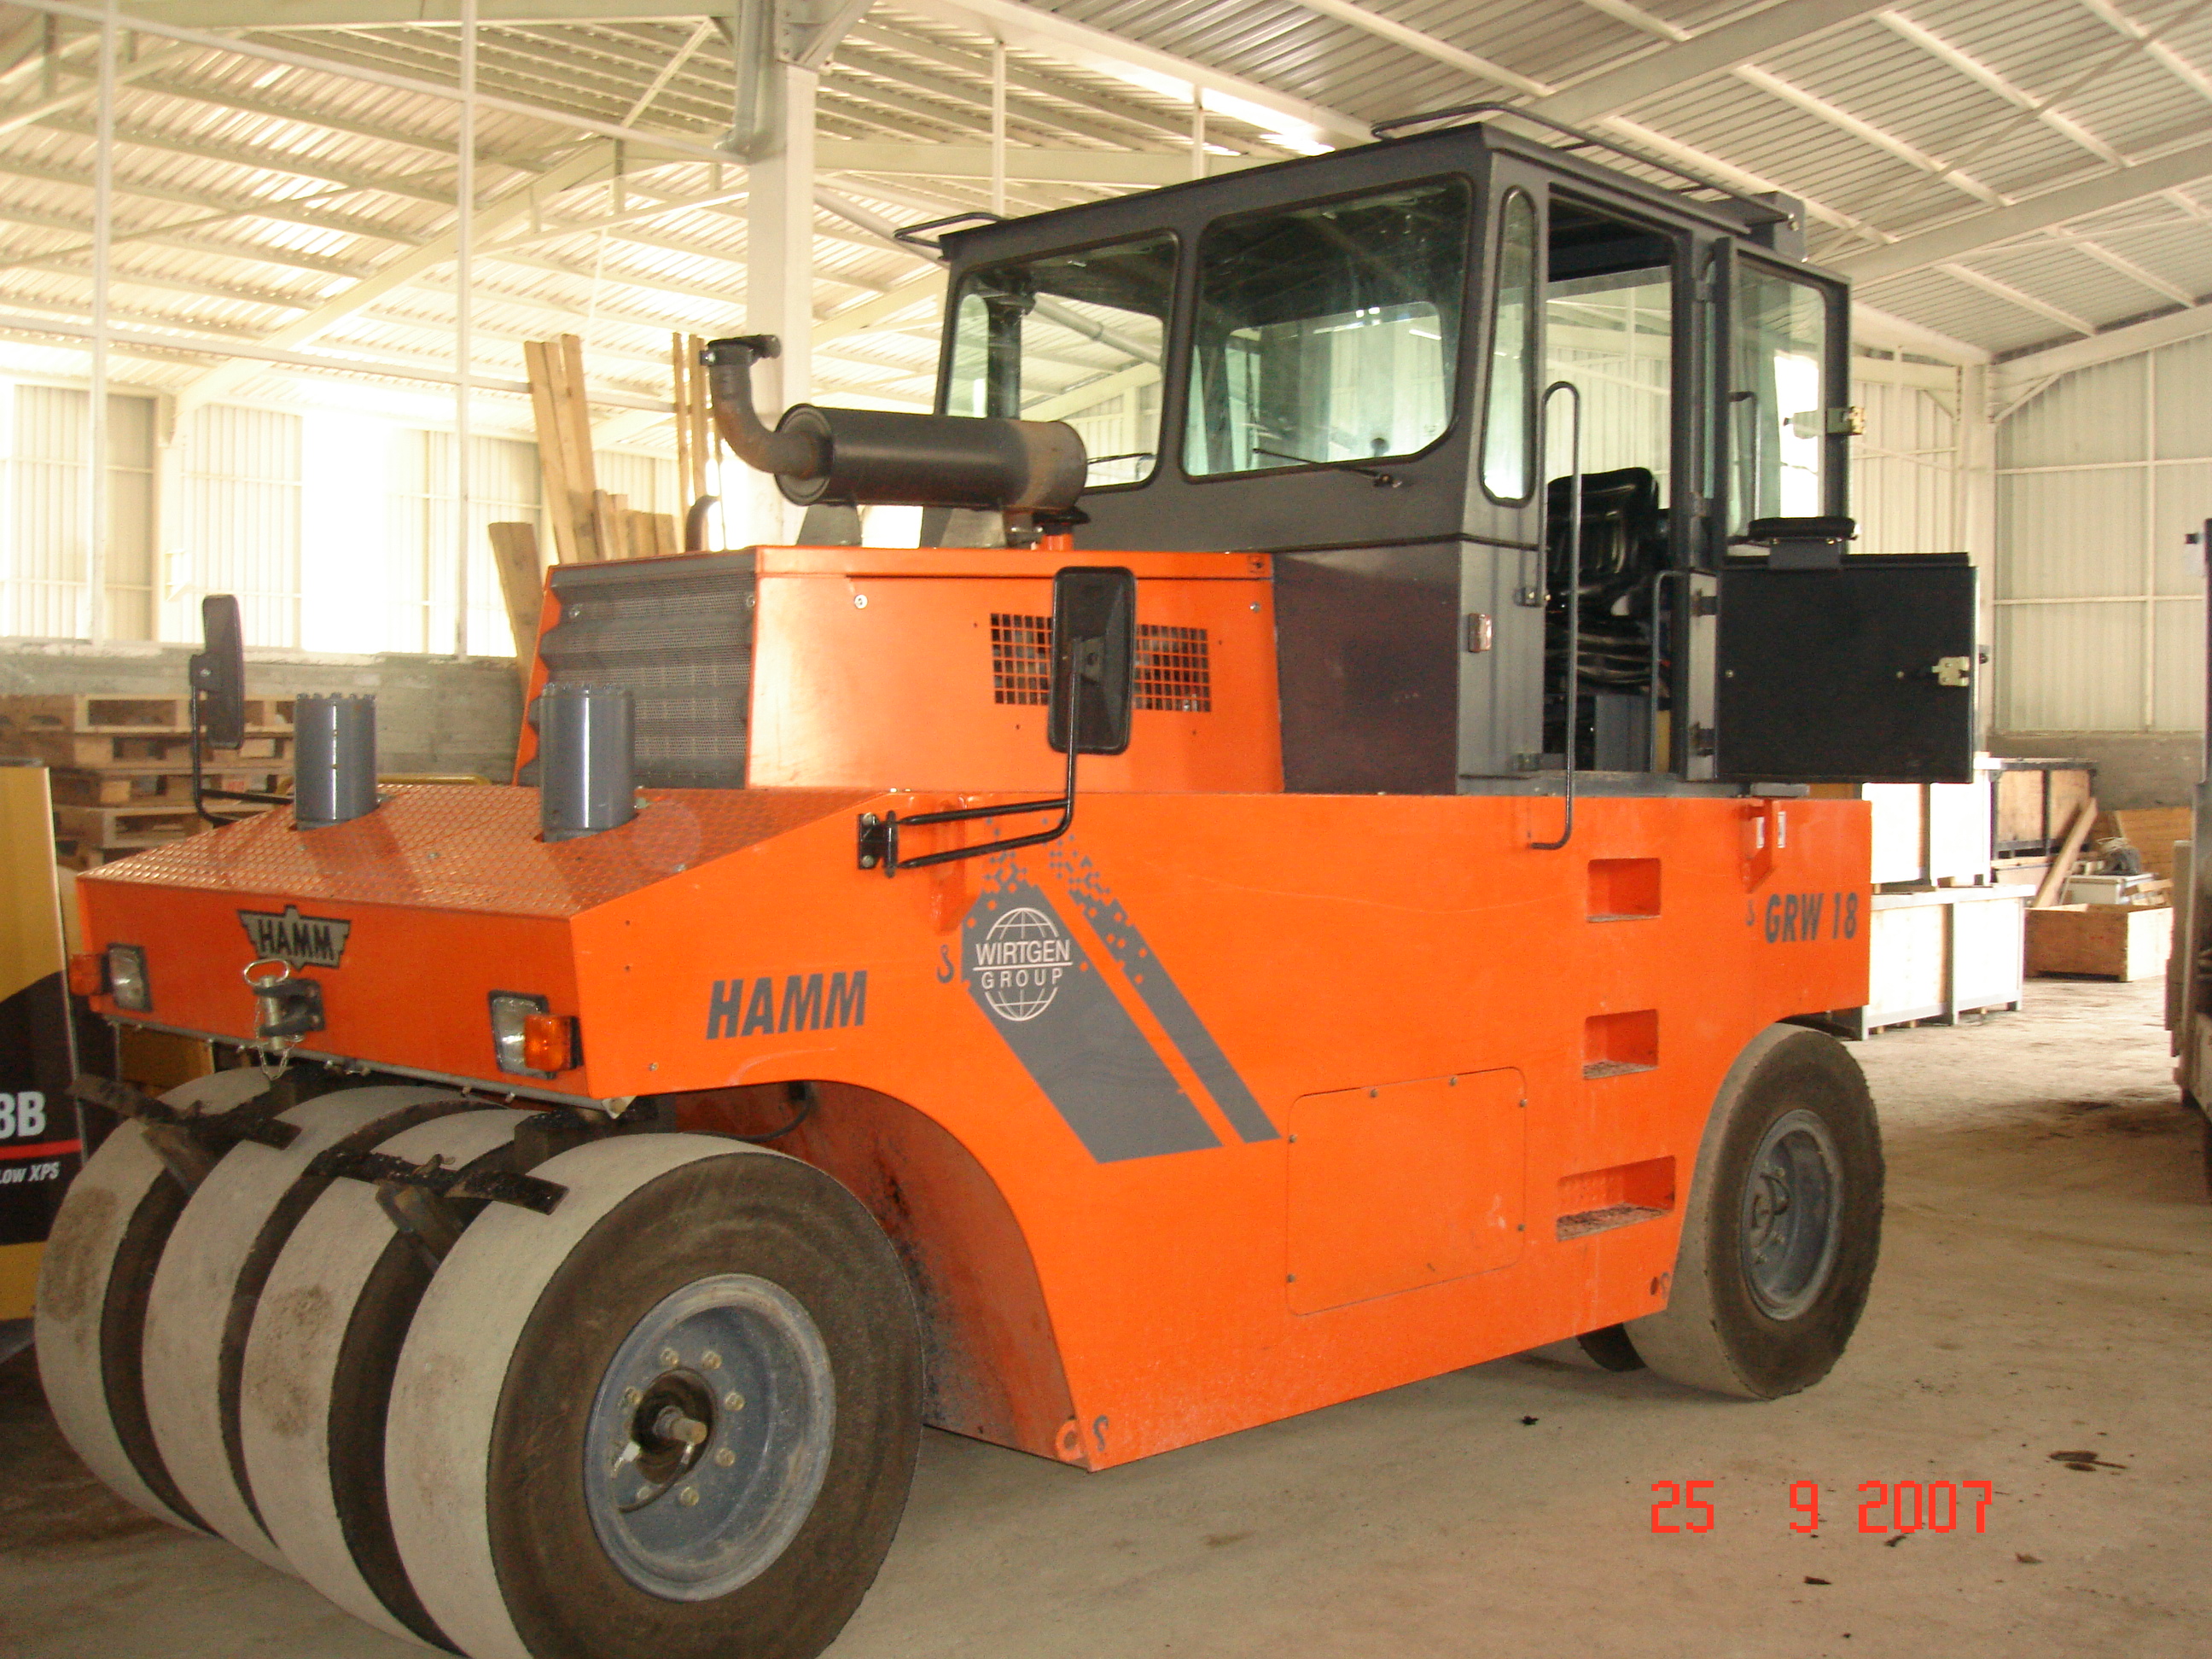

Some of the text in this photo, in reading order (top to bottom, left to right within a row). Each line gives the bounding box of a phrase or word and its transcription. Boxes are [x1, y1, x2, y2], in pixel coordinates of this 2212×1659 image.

[1764, 892, 1859, 944] GRW 18
[258, 918, 335, 961] HAMM
[975, 939, 1071, 966] WIRTGEN
[981, 967, 1063, 990] GROUP
[706, 970, 867, 1040] HAMM
[28, 1161, 61, 1182] XPS
